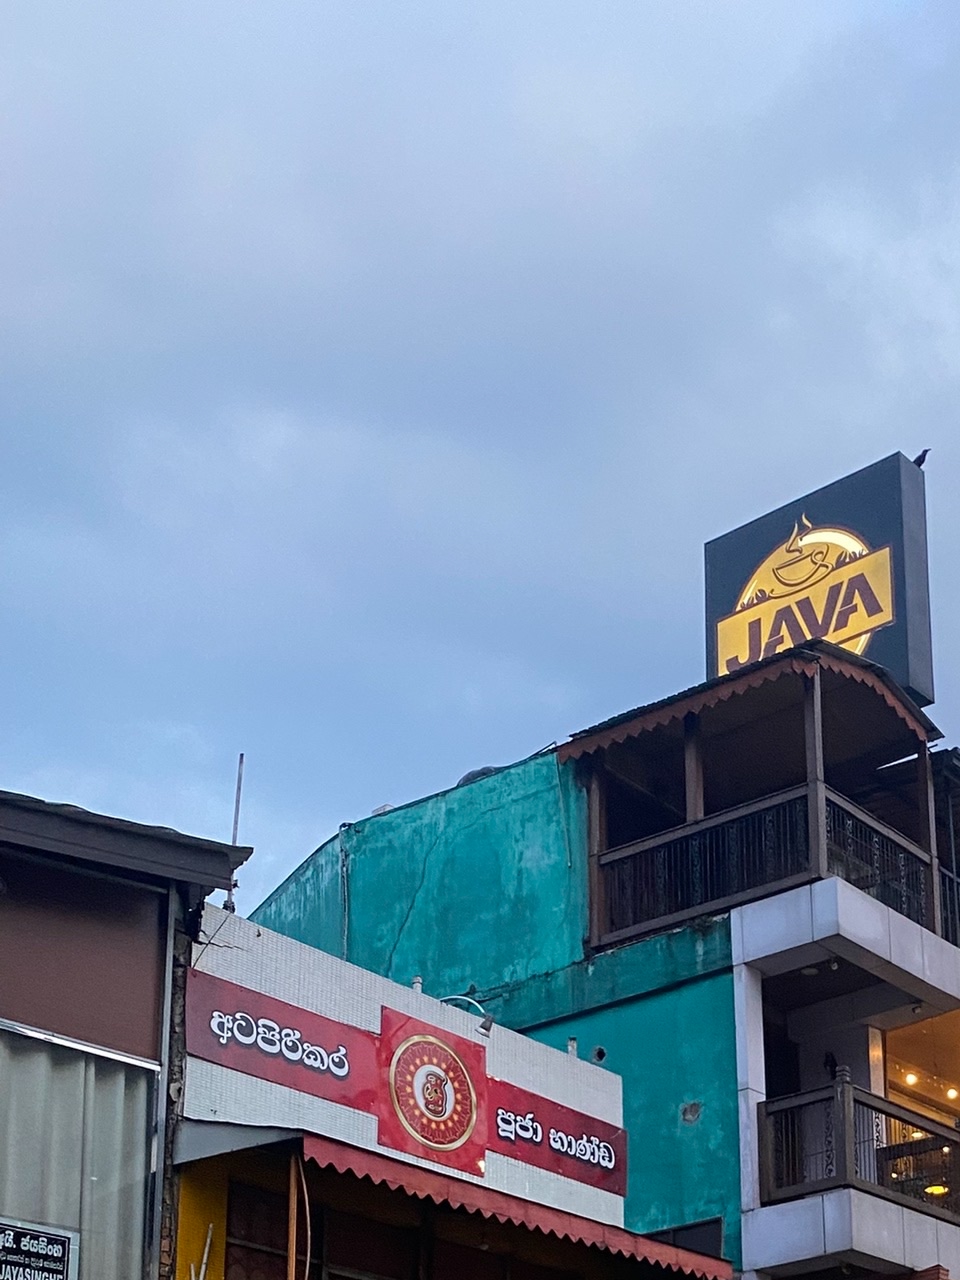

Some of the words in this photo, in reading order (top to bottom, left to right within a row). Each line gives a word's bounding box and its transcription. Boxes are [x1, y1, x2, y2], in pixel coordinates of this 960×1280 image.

[726, 573, 883, 671] JAVA
[209, 1011, 349, 1077] අටපිරිකර
[497, 1108, 543, 1143] පූජා
[549, 1128, 616, 1169] භාණ්ඩ
